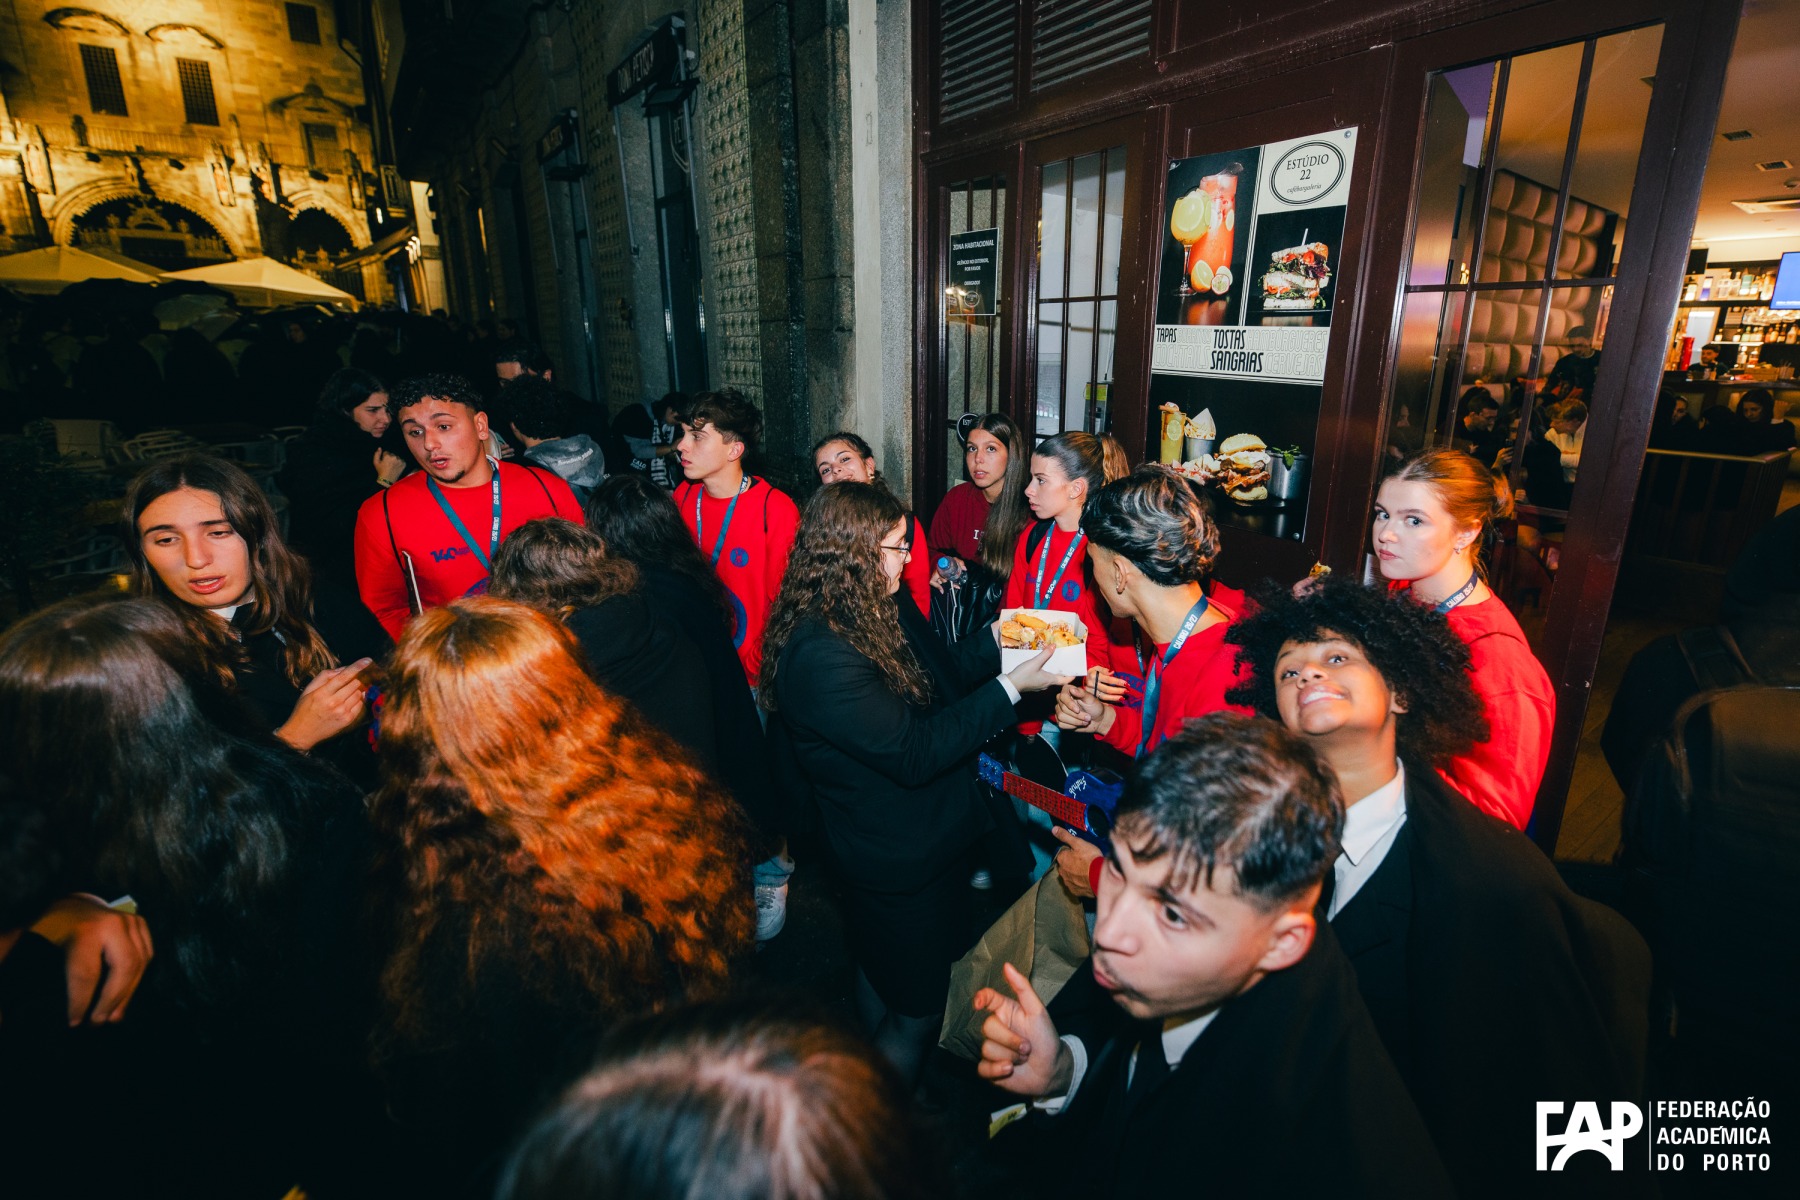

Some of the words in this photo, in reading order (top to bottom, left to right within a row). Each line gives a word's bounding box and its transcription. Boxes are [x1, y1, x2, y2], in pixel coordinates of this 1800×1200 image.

[1286, 153, 1330, 171] ESTÚDIO
[1299, 168, 1311, 181] 22
[965, 240, 994, 249] HABITACIONAL
[1156, 327, 1178, 343] TAPAS
[1213, 329, 1247, 350] TOSTAS
[1246, 327, 1328, 353] HAMBÚRGUERES
[1153, 344, 1211, 370] COCKTAILS
[1210, 350, 1264, 373] SANGRIAS
[1264, 352, 1325, 377] CERVEJAS
